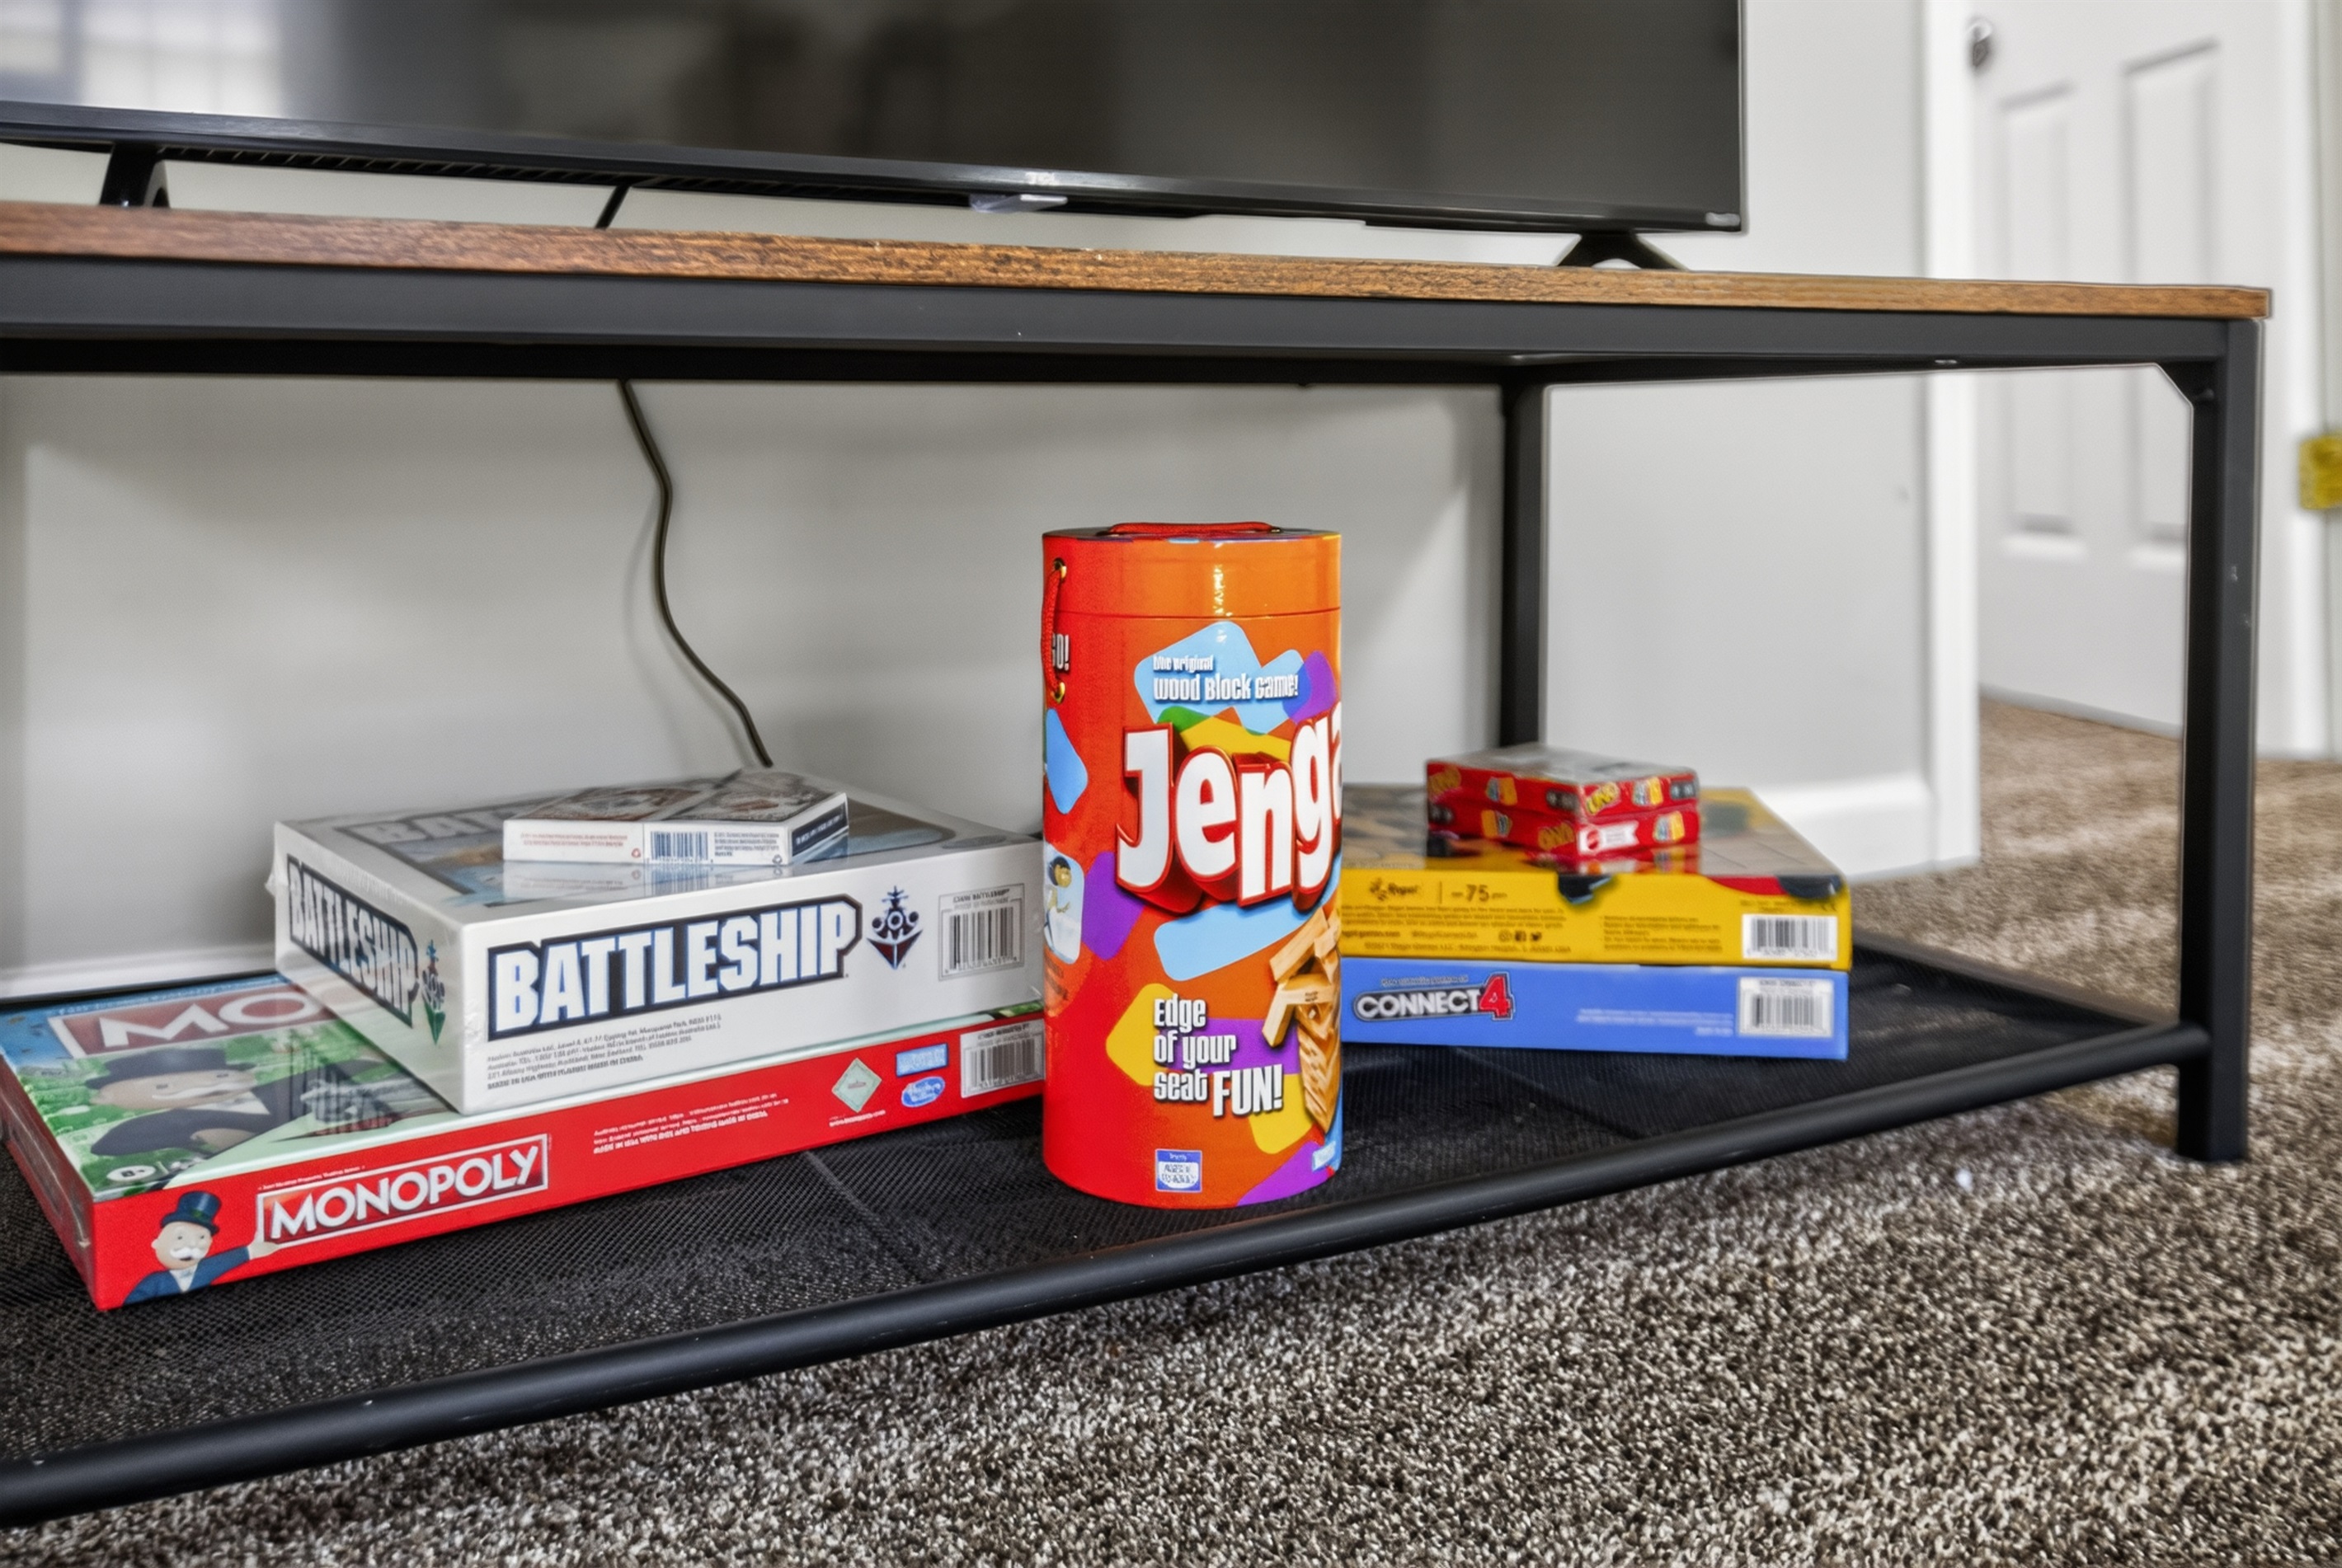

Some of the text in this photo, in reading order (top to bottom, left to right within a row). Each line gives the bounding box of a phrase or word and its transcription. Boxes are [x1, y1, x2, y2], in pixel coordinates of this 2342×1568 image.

[289, 861, 417, 1022] BATTLESHIP
[491, 899, 858, 1036] BATTLESHIP
[1154, 993, 1206, 1033] Edge
[1357, 973, 1514, 1020] CONNECT 4
[1154, 1030, 1237, 1069] of your
[1154, 1063, 1283, 1118] seat FUN!
[270, 1144, 540, 1240] MONOPOLY
